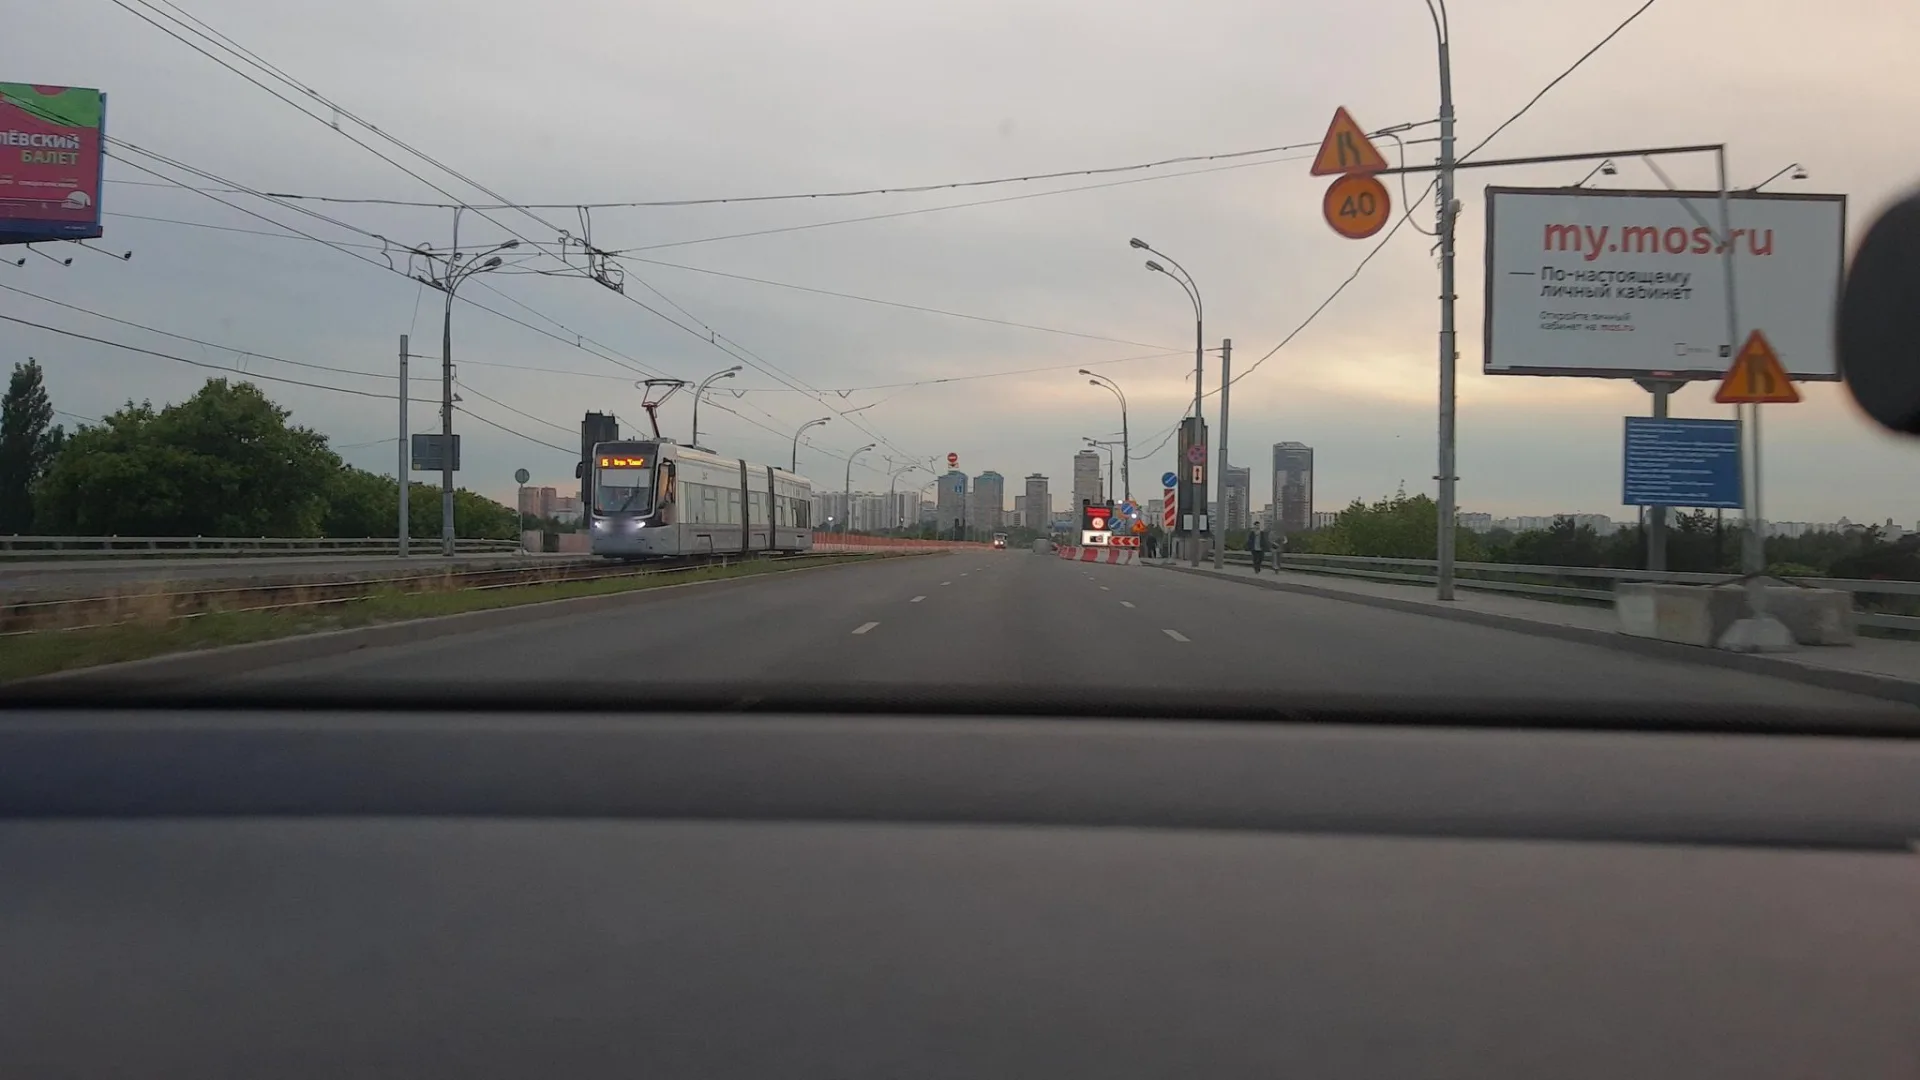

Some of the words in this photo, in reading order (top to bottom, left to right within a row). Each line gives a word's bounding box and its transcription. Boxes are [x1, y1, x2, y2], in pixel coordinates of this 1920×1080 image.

[22, 149, 79, 164] БАЛЕТ
[1339, 191, 1375, 218] 40
[1543, 222, 1774, 261] my.mos.ru
[1541, 266, 1692, 288] По-настоящему
[1540, 283, 1612, 299] личный
[1616, 286, 1693, 300] кабинет
